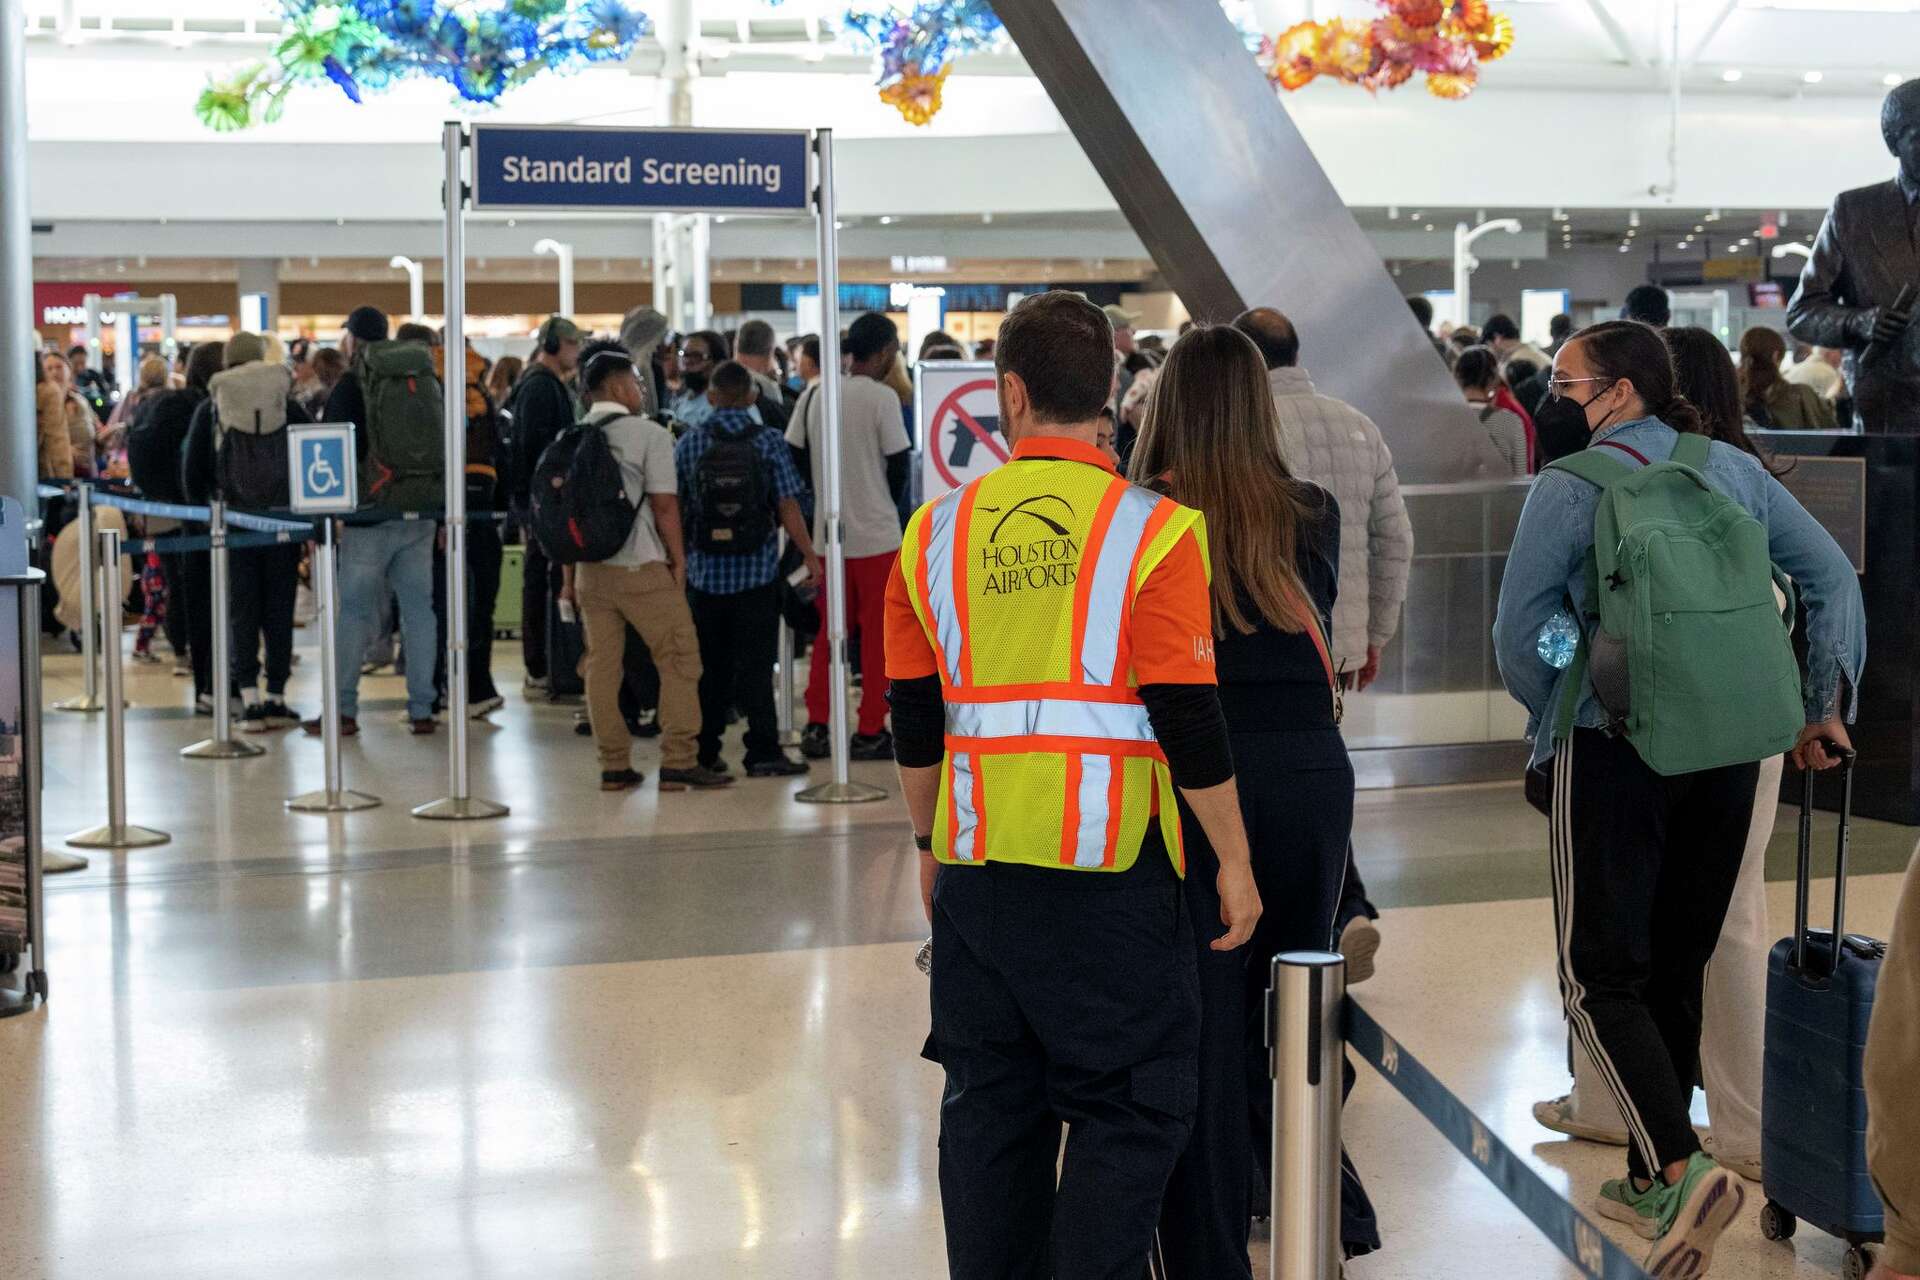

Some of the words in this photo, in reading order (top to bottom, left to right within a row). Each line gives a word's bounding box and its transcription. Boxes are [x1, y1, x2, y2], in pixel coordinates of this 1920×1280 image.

[502, 155, 632, 184] Standard
[642, 158, 781, 193] Screening
[982, 538, 1081, 569] HOUSTON
[982, 562, 1077, 596] AIRPORTS
